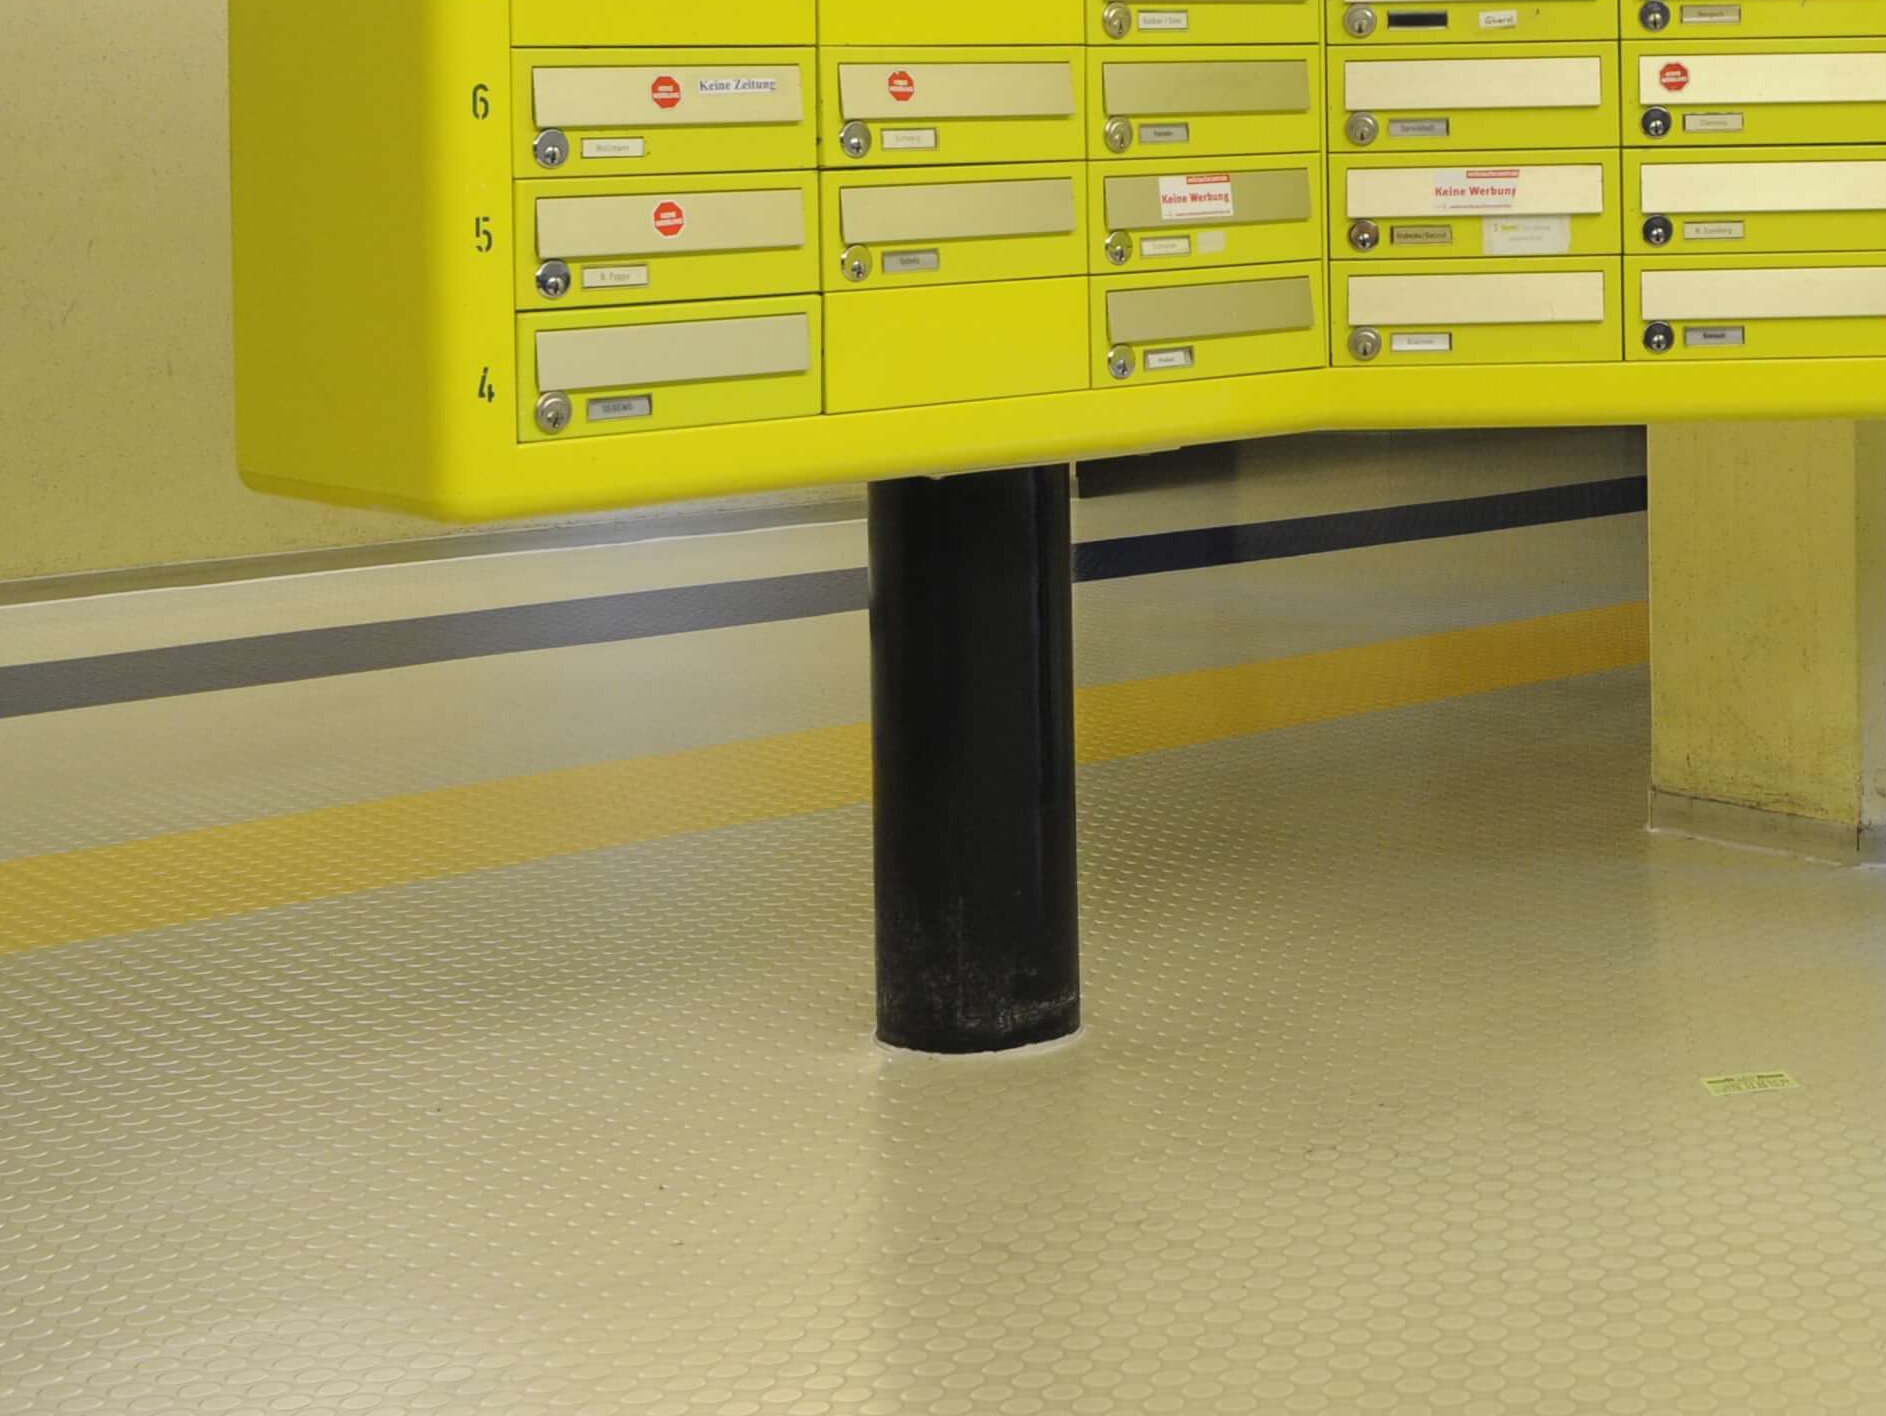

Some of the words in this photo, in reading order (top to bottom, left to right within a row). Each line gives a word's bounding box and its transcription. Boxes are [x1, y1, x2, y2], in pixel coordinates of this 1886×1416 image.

[699, 79, 731, 92] Keine
[733, 78, 777, 92] Zeitung
[472, 83, 490, 120] 6
[1161, 193, 1187, 204] Keine
[1189, 192, 1230, 204] Werbung
[1434, 186, 1466, 197] Keine
[475, 216, 493, 253] 5
[477, 367, 495, 403] 4
